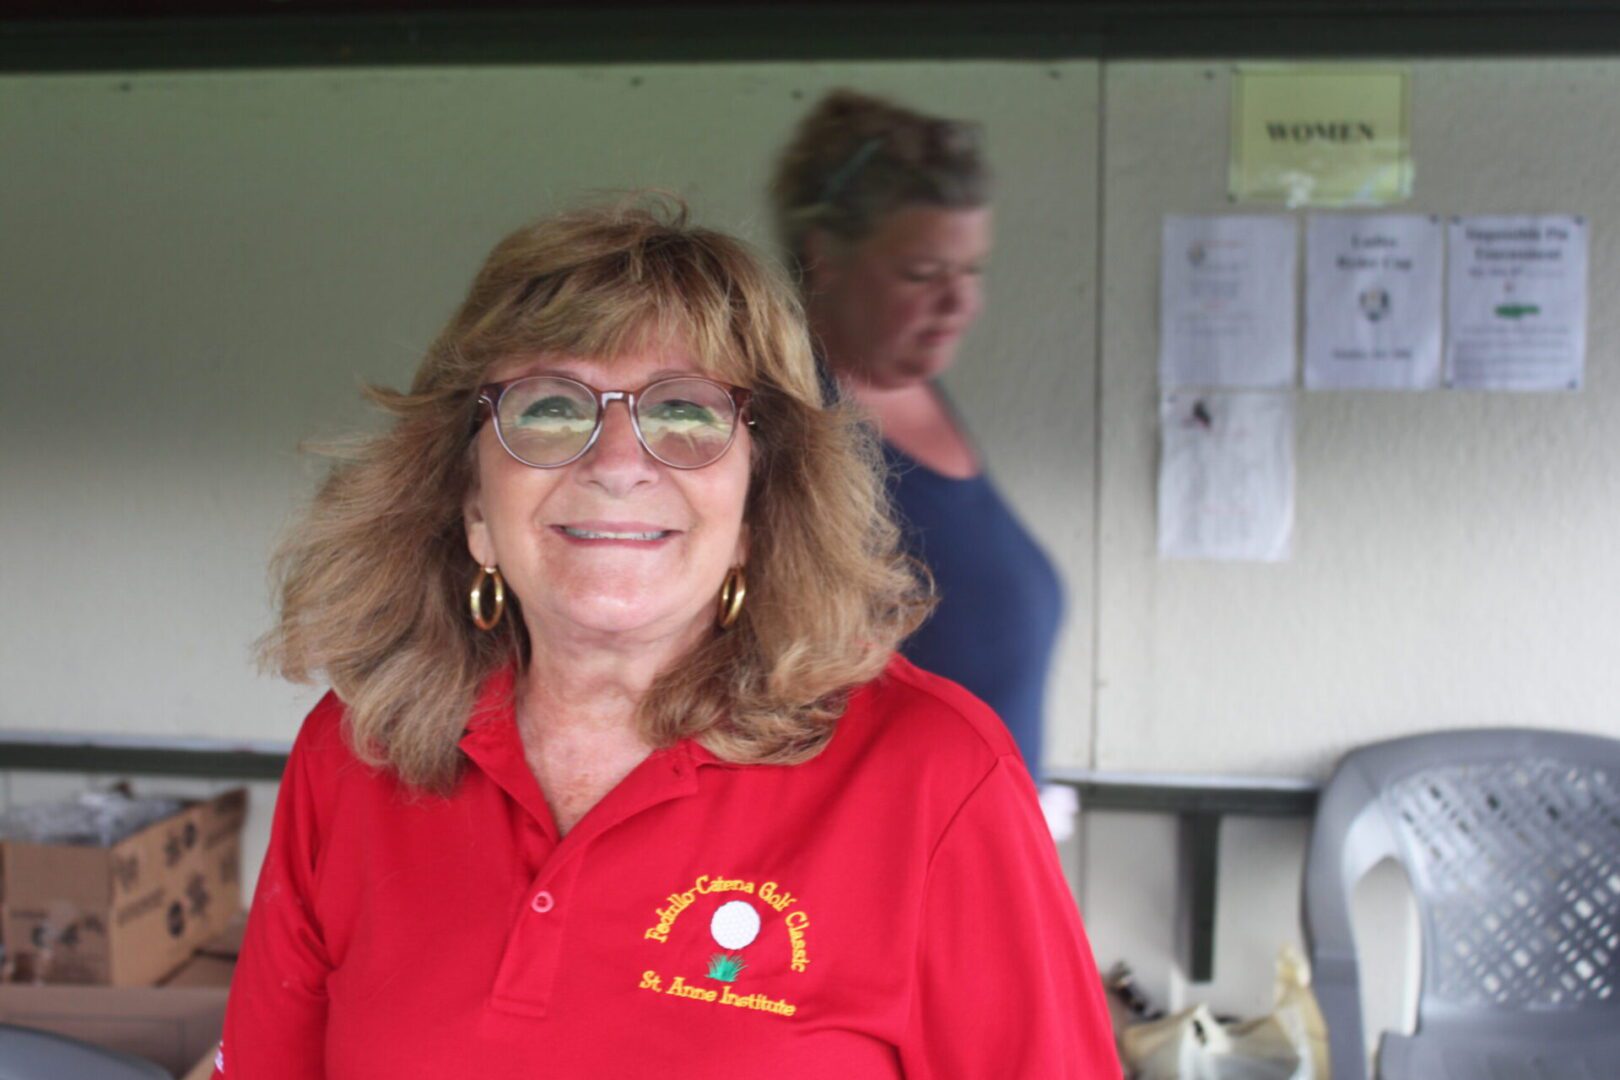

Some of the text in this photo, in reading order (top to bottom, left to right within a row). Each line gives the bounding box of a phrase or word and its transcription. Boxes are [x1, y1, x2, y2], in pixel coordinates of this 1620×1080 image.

[1266, 121, 1375, 142] WOMEN
[758, 881, 798, 912] Golf
[785, 911, 811, 973] Classic
[639, 969, 797, 1017] St. Anne Institute
